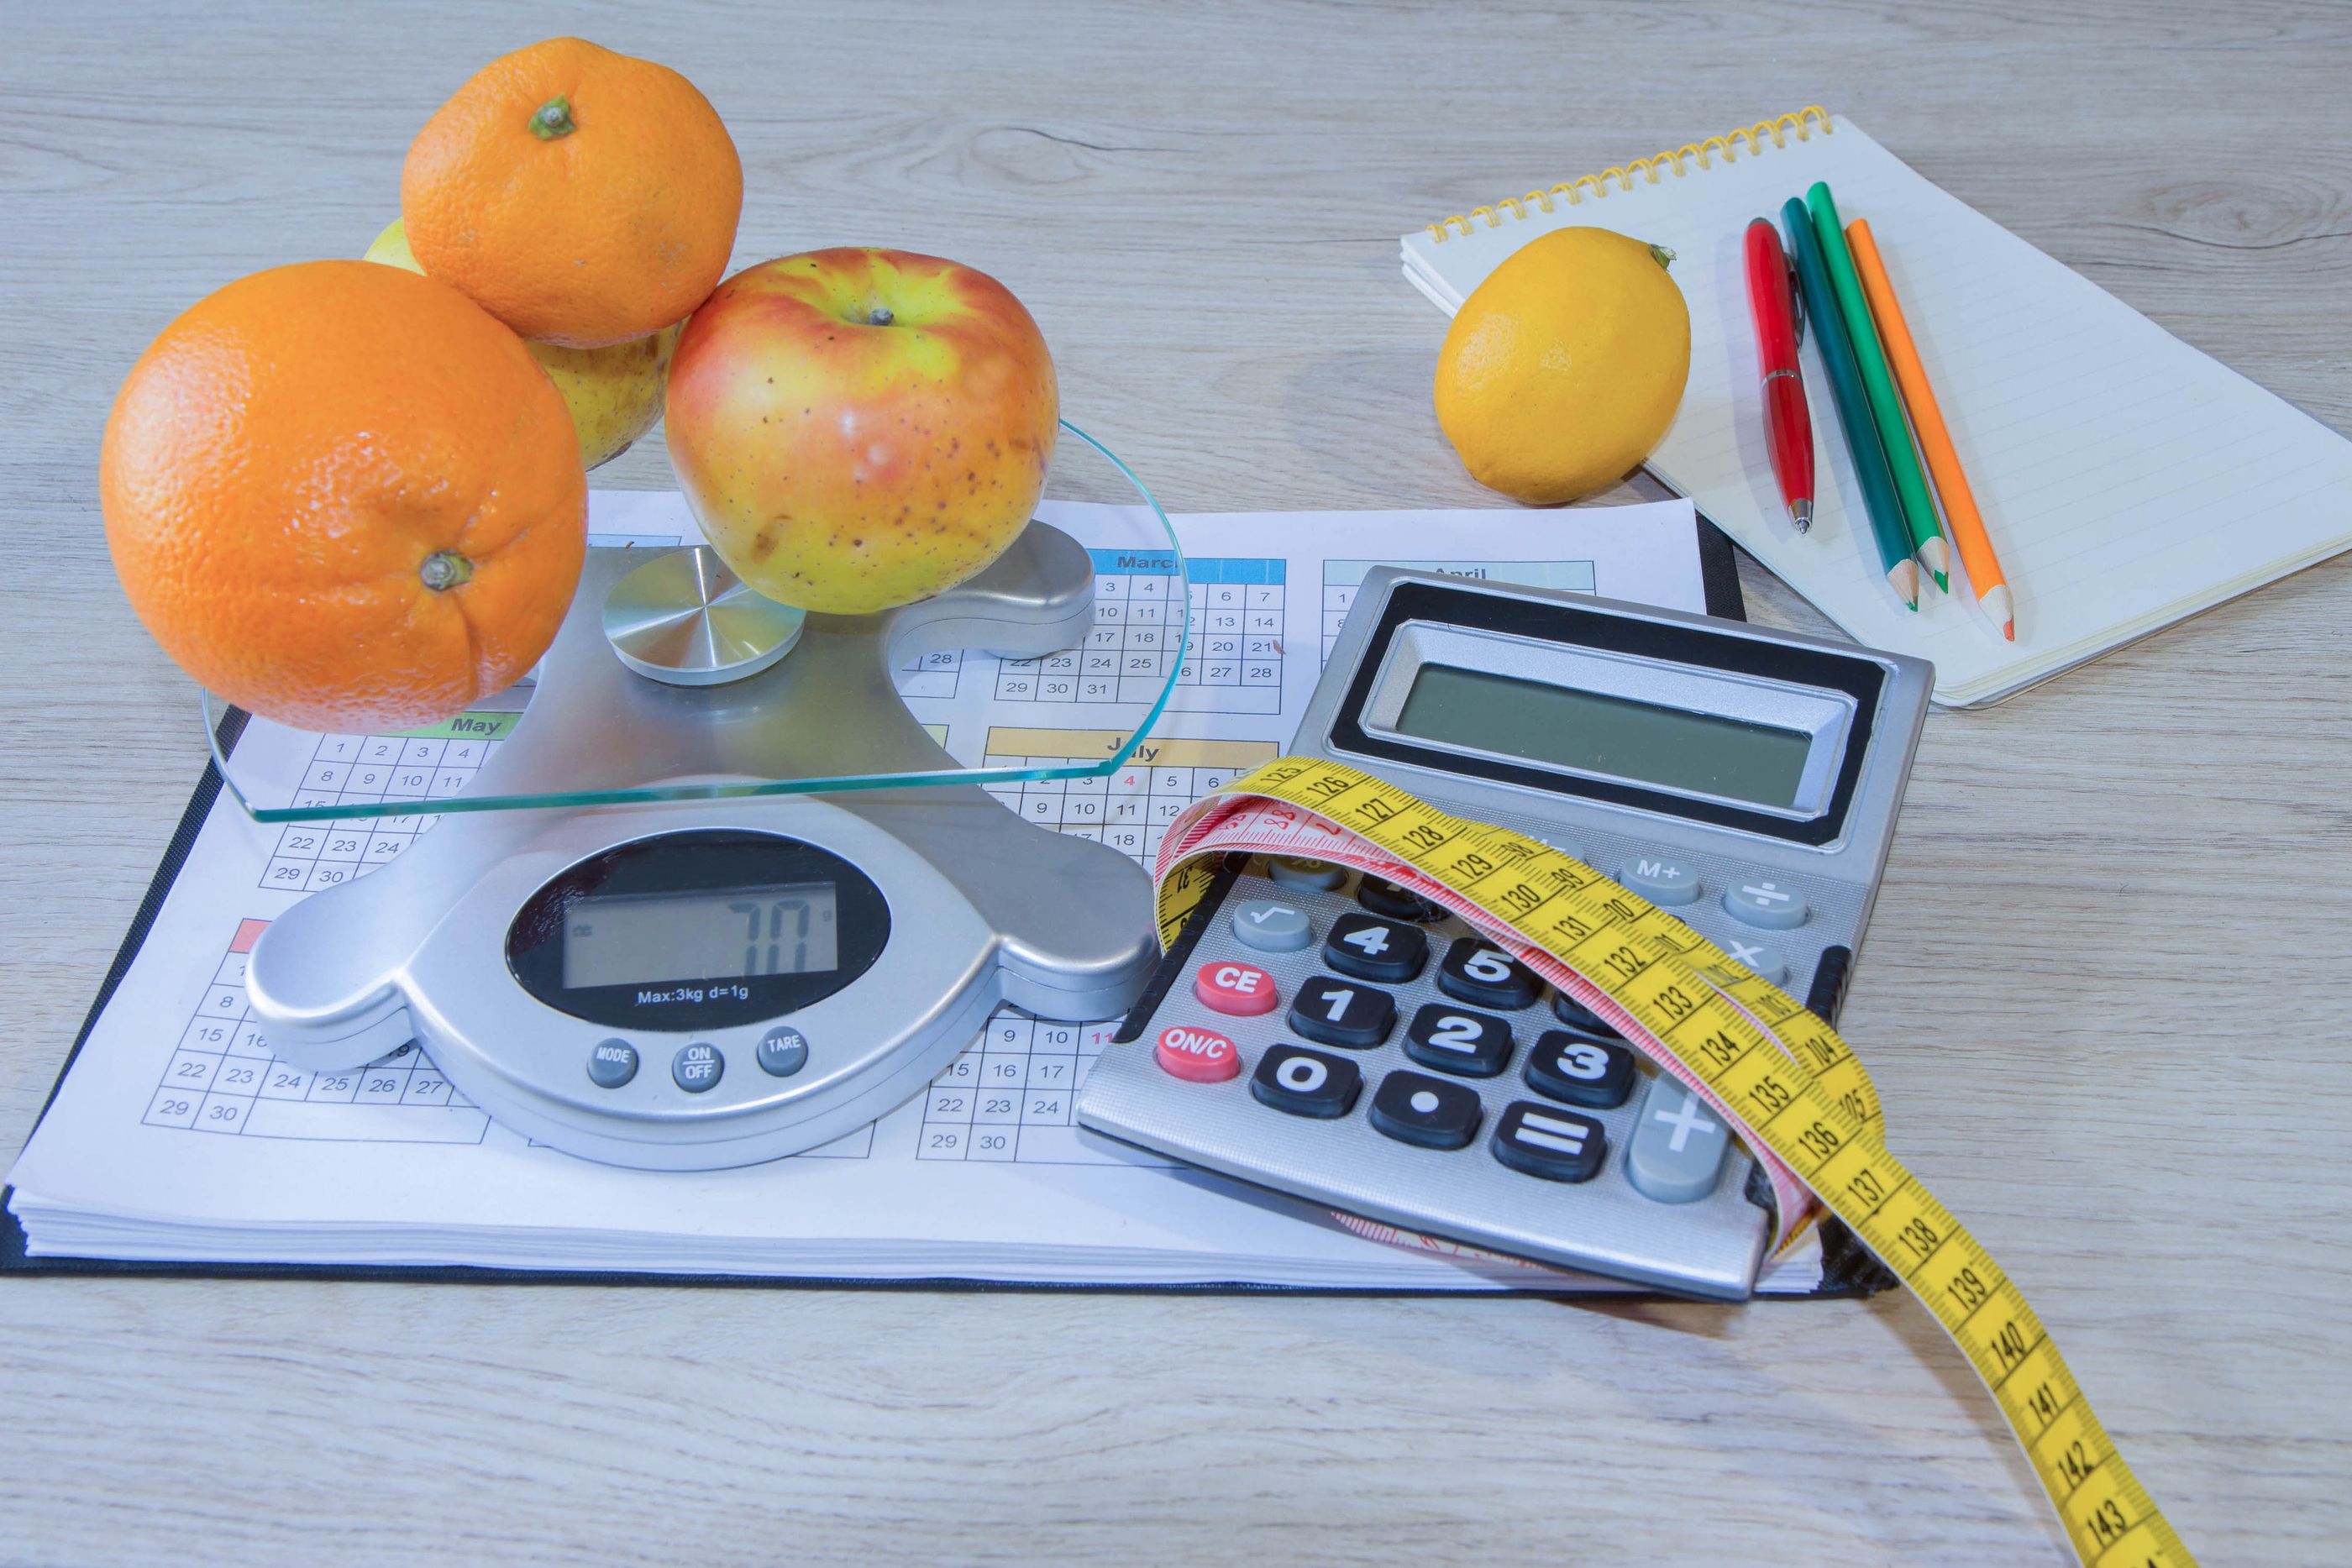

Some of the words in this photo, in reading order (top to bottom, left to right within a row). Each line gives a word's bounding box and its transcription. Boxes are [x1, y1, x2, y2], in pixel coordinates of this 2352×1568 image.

[1105, 583, 1116, 592] 3
[1143, 583, 1154, 592] 4
[1221, 592, 1231, 601] 6
[1260, 592, 1271, 602] 7
[1339, 594, 1346, 603] 1
[1099, 608, 1118, 618] 10
[1137, 609, 1155, 618] 11
[1216, 617, 1235, 627] 13
[1255, 618, 1274, 627] 14
[1095, 633, 1115, 643] 17
[1135, 633, 1154, 643] 18
[1212, 642, 1233, 652] 20
[1252, 642, 1272, 652] 21
[930, 653, 952, 664] 28
[1050, 658, 1072, 668] 23
[1090, 658, 1111, 669] 24
[1130, 658, 1152, 669] 25
[1210, 668, 1231, 677] 27
[1251, 668, 1272, 678] 28
[1005, 683, 1028, 693] 29
[1047, 684, 1068, 694] 30
[1087, 684, 1106, 695] 31
[451, 718, 502, 736] May
[337, 743, 345, 753] 1
[375, 745, 387, 756] 2
[417, 747, 428, 758] 3
[459, 748, 470, 758] 4
[1107, 737, 1159, 760] Jly
[321, 771, 333, 782] 8
[363, 774, 375, 784] 9
[402, 774, 423, 786] 10
[443, 777, 463, 788] 11
[1124, 775, 1136, 785] 4
[1167, 776, 1177, 786] 5
[1208, 778, 1219, 788] 6
[1261, 767, 1301, 782] 125
[1307, 777, 1349, 797] 126
[1037, 803, 1047, 814] 9
[1074, 804, 1095, 815] 10
[1116, 805, 1136, 815] 11
[1159, 805, 1180, 816] 12
[1356, 799, 1395, 821] 127
[1264, 810, 1295, 830] 88
[288, 836, 314, 850] 22
[331, 840, 357, 852] 23
[375, 842, 399, 854] 24
[1115, 835, 1135, 846] 18
[1403, 825, 1445, 848] 128
[275, 868, 301, 880] 29
[319, 871, 344, 883] 30
[1452, 853, 1492, 878] 129
[1637, 860, 1680, 878] M+
[1551, 868, 1583, 889] 99
[1501, 884, 1541, 911] 130
[1552, 915, 1592, 941] 131
[1344, 926, 1389, 956] 4
[1464, 949, 1510, 983] 5
[1604, 947, 1646, 977] 132
[1215, 966, 1262, 993] CE
[220, 996, 234, 1008] 8
[638, 989, 703, 1004] Max:3kg
[709, 985, 749, 1000] d=1g
[1653, 986, 1693, 1020] 133
[1321, 989, 1354, 1021] 1
[199, 1028, 223, 1041] 15
[768, 1035, 801, 1052] TARE
[1004, 1030, 1016, 1042] 9
[1047, 1031, 1068, 1044] 10
[1092, 1032, 1113, 1044] 11
[1165, 1029, 1227, 1059] ON/C
[1429, 1017, 1483, 1054] 2
[596, 1046, 630, 1063] MODE
[688, 1047, 711, 1061] ON
[1700, 1030, 1740, 1066] 134
[1805, 1036, 1838, 1066] 104
[947, 1063, 969, 1077] 15
[994, 1064, 1016, 1078] 16
[1041, 1066, 1063, 1078] 17
[1557, 1043, 1609, 1080] 3
[178, 1062, 207, 1078] 22
[225, 1067, 254, 1083] 23
[274, 1073, 301, 1088] 24
[321, 1077, 349, 1091] 25
[369, 1079, 396, 1093] 26
[415, 1080, 444, 1094] 27
[685, 1065, 712, 1079] OFF
[1277, 1057, 1327, 1092] 0
[1749, 1076, 1790, 1113] 135
[160, 1100, 188, 1115] 29
[209, 1106, 238, 1120] 30
[938, 1099, 963, 1112] 22
[985, 1100, 1011, 1113] 23
[1033, 1101, 1058, 1114] 24
[932, 1135, 957, 1148] 29
[980, 1136, 1006, 1150] 30
[1799, 1122, 1839, 1160] 136
[1847, 1169, 1885, 1208] 137
[1898, 1218, 1938, 1259] 138
[1947, 1268, 1986, 1310] 139
[1991, 1321, 2024, 1370] 140
[2029, 1382, 2060, 1428] 141
[2058, 1440, 2092, 1490] 142
[2087, 1500, 2127, 1548] 143
